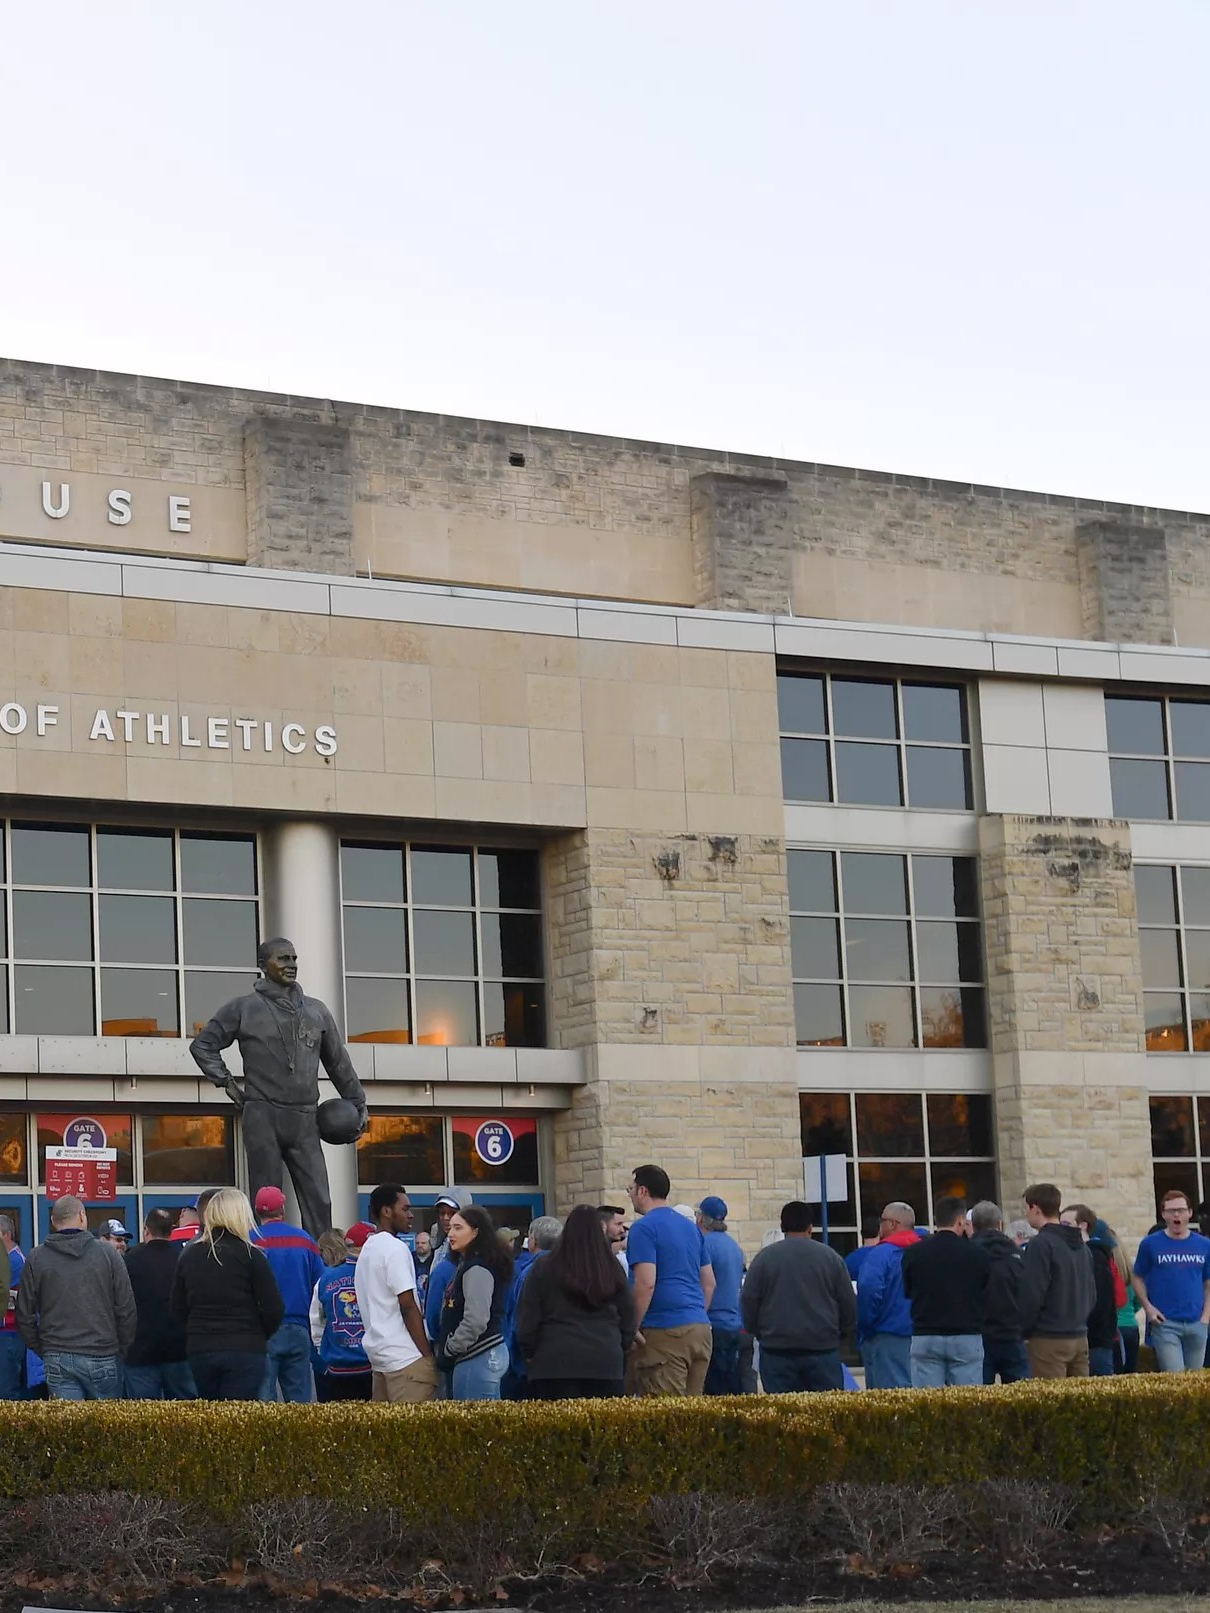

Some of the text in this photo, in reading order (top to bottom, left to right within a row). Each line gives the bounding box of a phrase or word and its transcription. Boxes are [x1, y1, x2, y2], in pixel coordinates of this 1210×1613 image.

[89, 708, 339, 757] ATHLETICS
[487, 1135, 502, 1158] 6
[1157, 1254, 1206, 1265] JAYHAWKS
[326, 1276, 356, 1293] NATI
